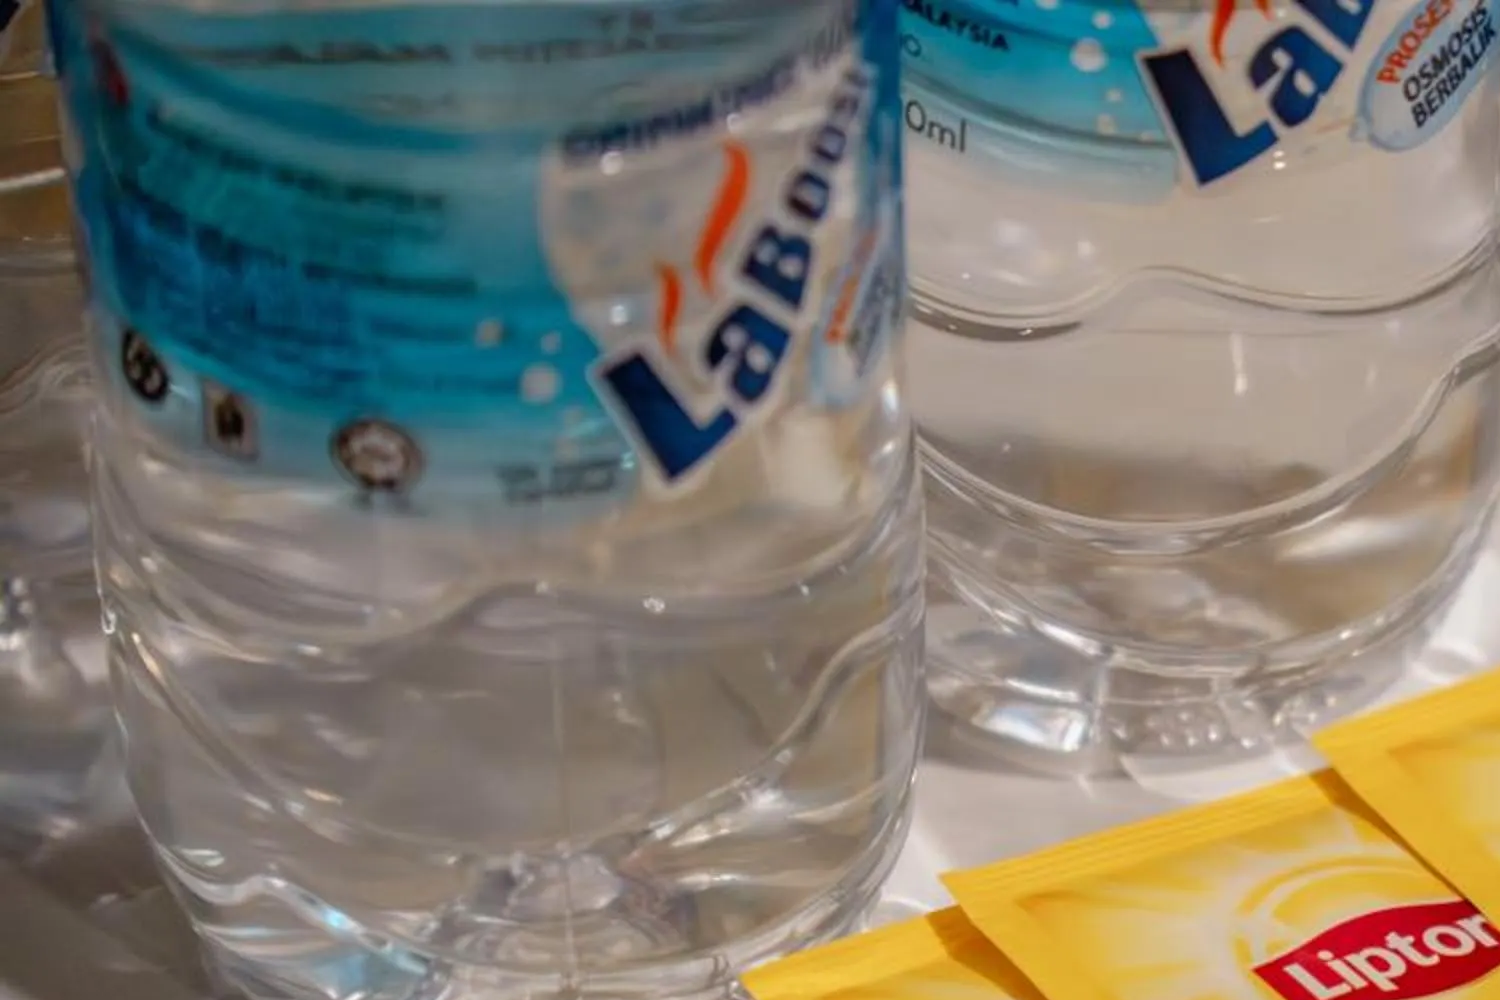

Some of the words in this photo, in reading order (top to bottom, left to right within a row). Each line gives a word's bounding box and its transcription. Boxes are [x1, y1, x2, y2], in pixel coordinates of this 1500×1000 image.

[903, 0, 1010, 51] ALAYSIA
[1411, 16, 1496, 129] BERBALIK
[905, 100, 967, 153] 0ml
